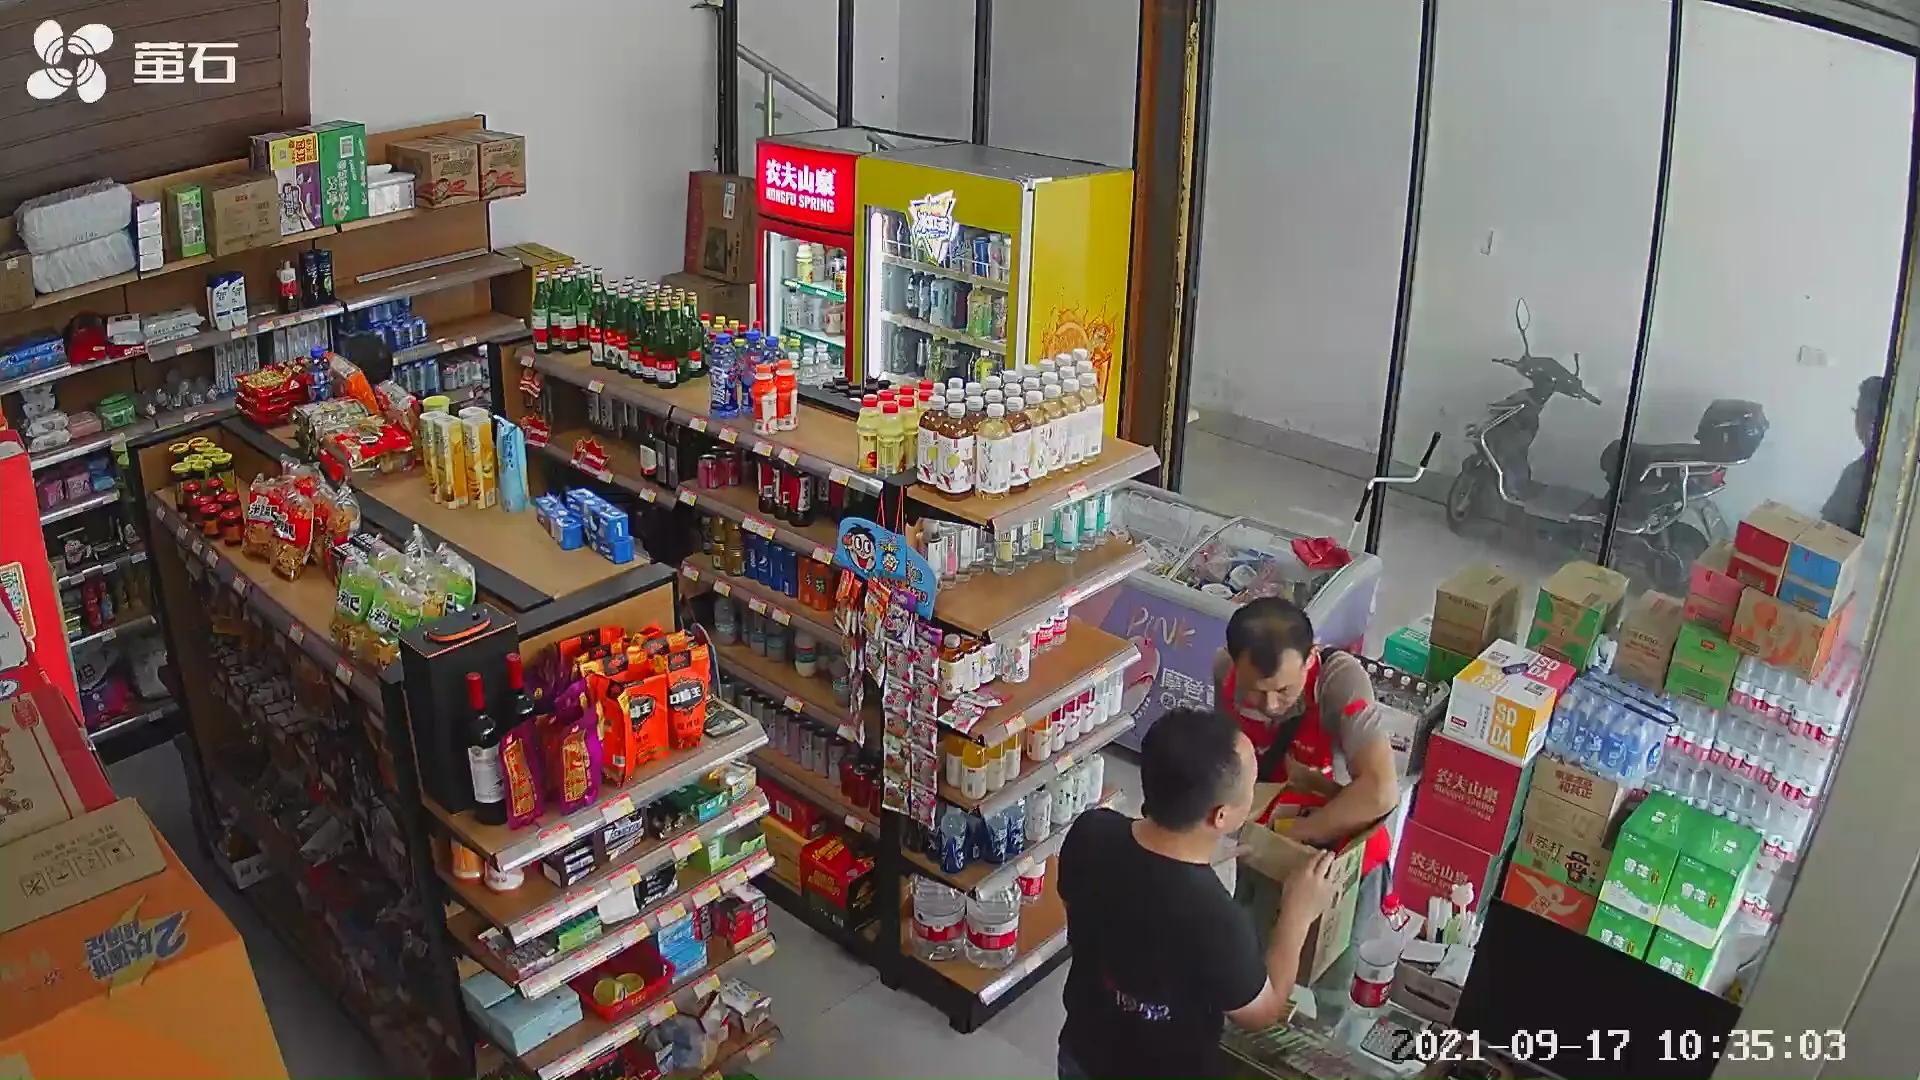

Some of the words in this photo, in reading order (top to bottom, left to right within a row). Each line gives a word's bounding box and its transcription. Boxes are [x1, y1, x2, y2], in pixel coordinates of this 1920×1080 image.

[766, 158, 836, 197] 农夫山泉
[766, 187, 797, 207] NONGFU
[798, 194, 835, 213] SPRING
[1496, 703, 1518, 728] SD
[1490, 725, 1512, 753] DA
[1436, 768, 1499, 804] 农夫山泉
